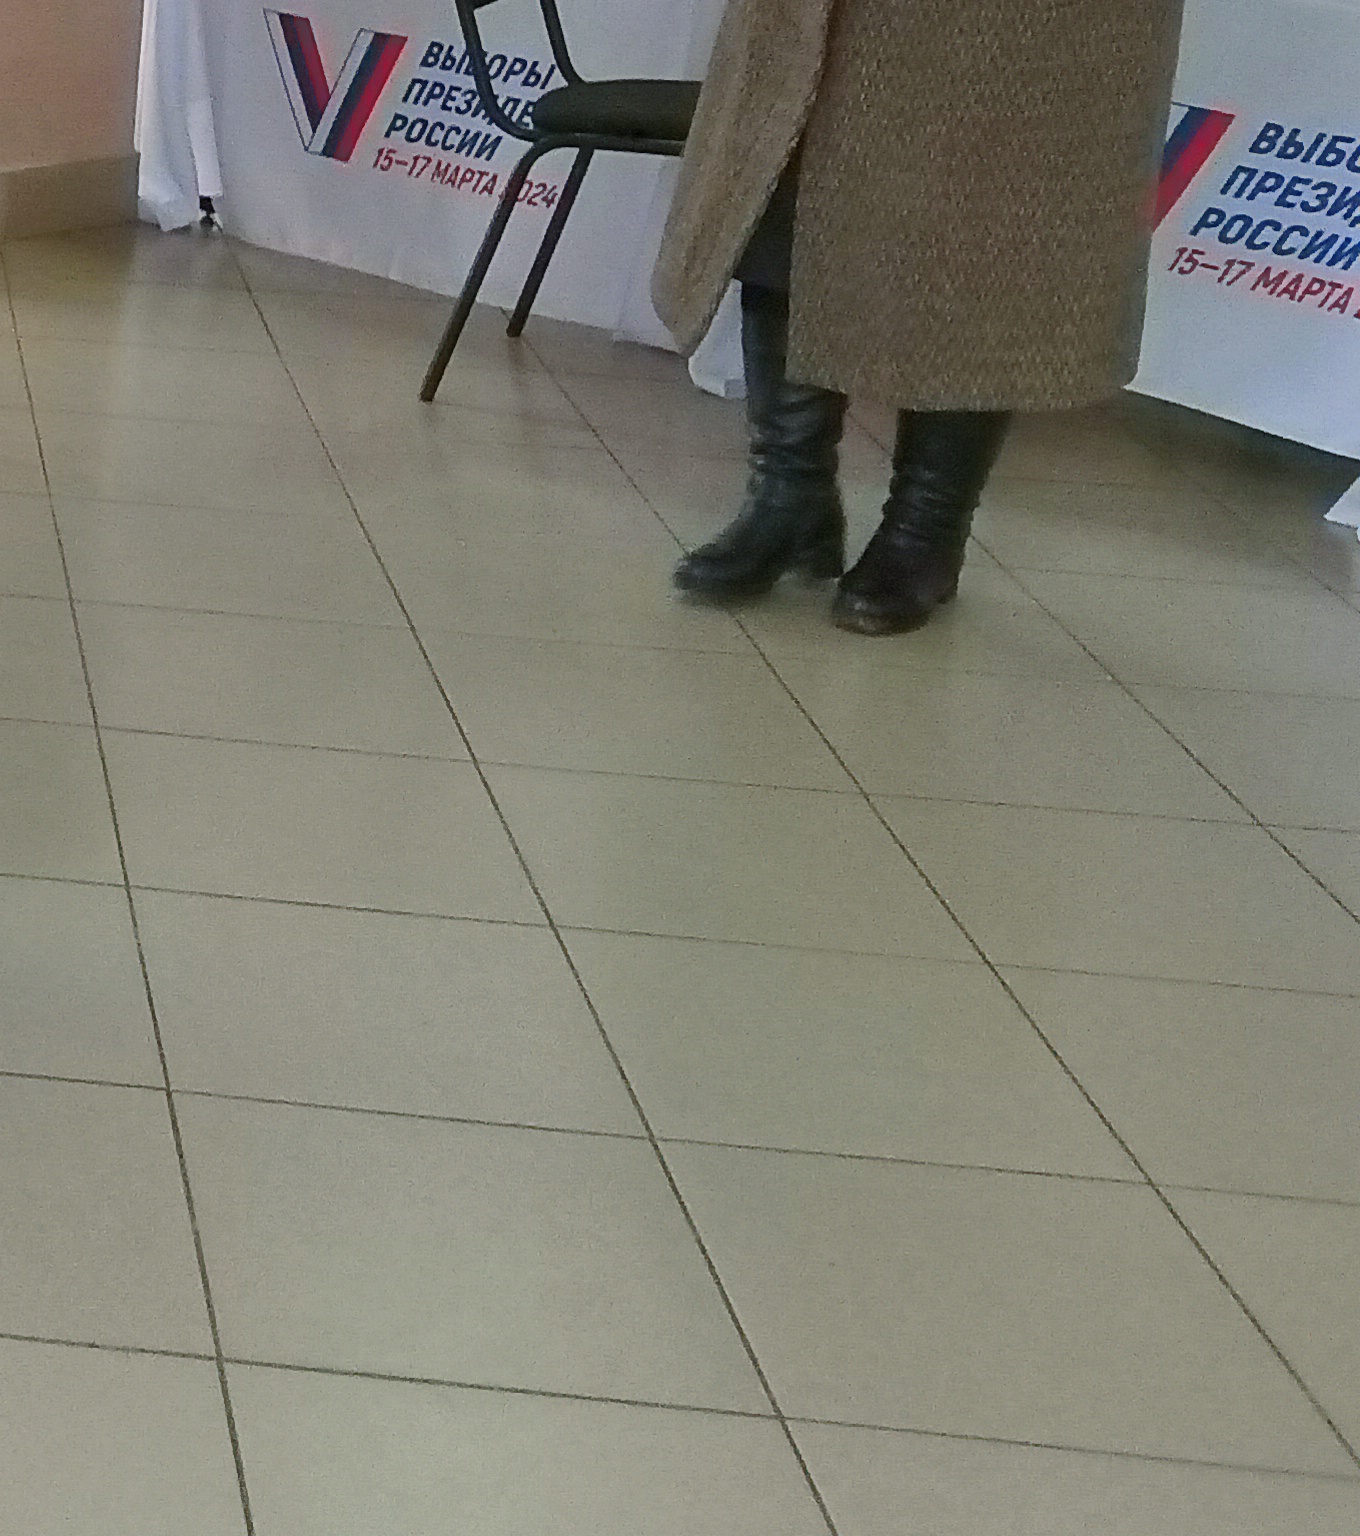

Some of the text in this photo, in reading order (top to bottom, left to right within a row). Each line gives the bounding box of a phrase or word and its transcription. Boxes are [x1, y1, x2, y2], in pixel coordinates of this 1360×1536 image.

[385, 112, 503, 162] РОССИИ
[430, 159, 499, 197] МАРТА
[498, 179, 559, 208] 024
[1220, 164, 1360, 228] ПРЕЗИ
[1250, 265, 1355, 315] МАРТА
